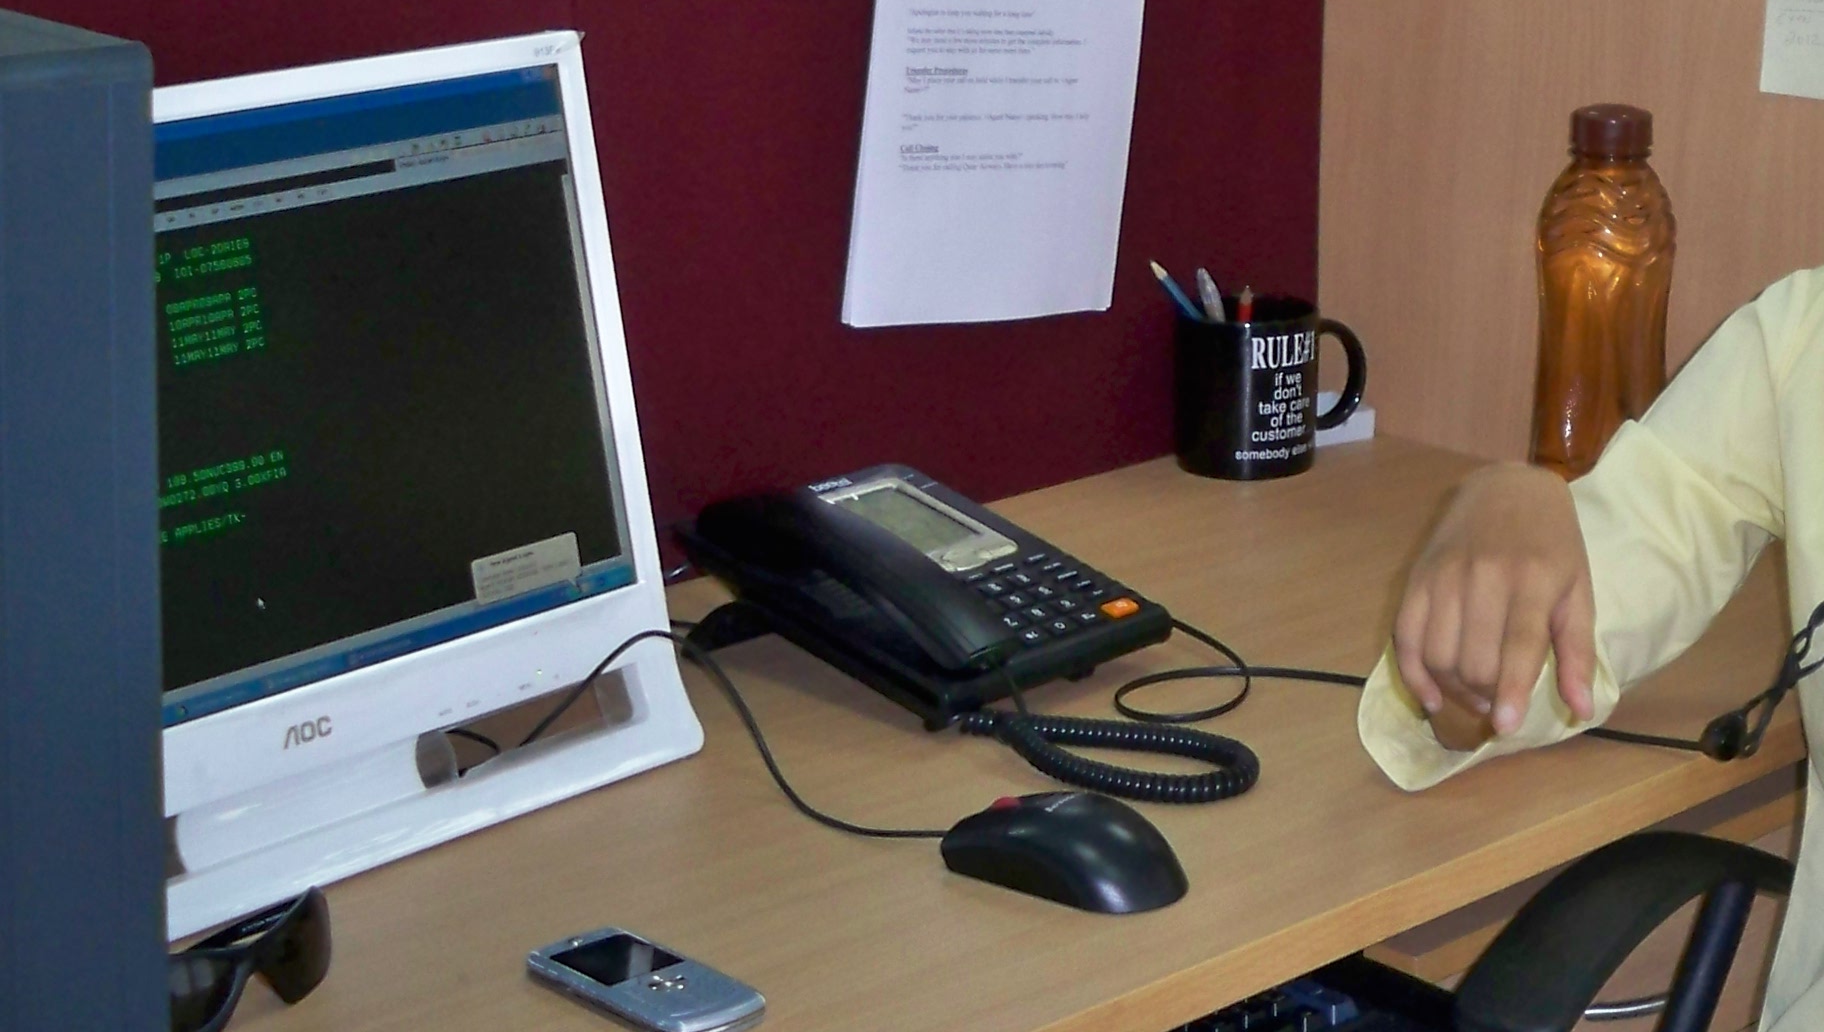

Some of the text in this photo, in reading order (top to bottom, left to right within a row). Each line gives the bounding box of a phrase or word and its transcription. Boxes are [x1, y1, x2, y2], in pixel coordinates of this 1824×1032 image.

[240, 303, 260, 317] 2PC
[245, 336, 265, 350] 2PC
[1274, 372, 1303, 387] if we
[1274, 384, 1303, 401] don't
[1258, 396, 1311, 416] take care
[1270, 411, 1304, 429] of the
[1251, 424, 1306, 443] customer
[1235, 446, 1290, 461] somebody
